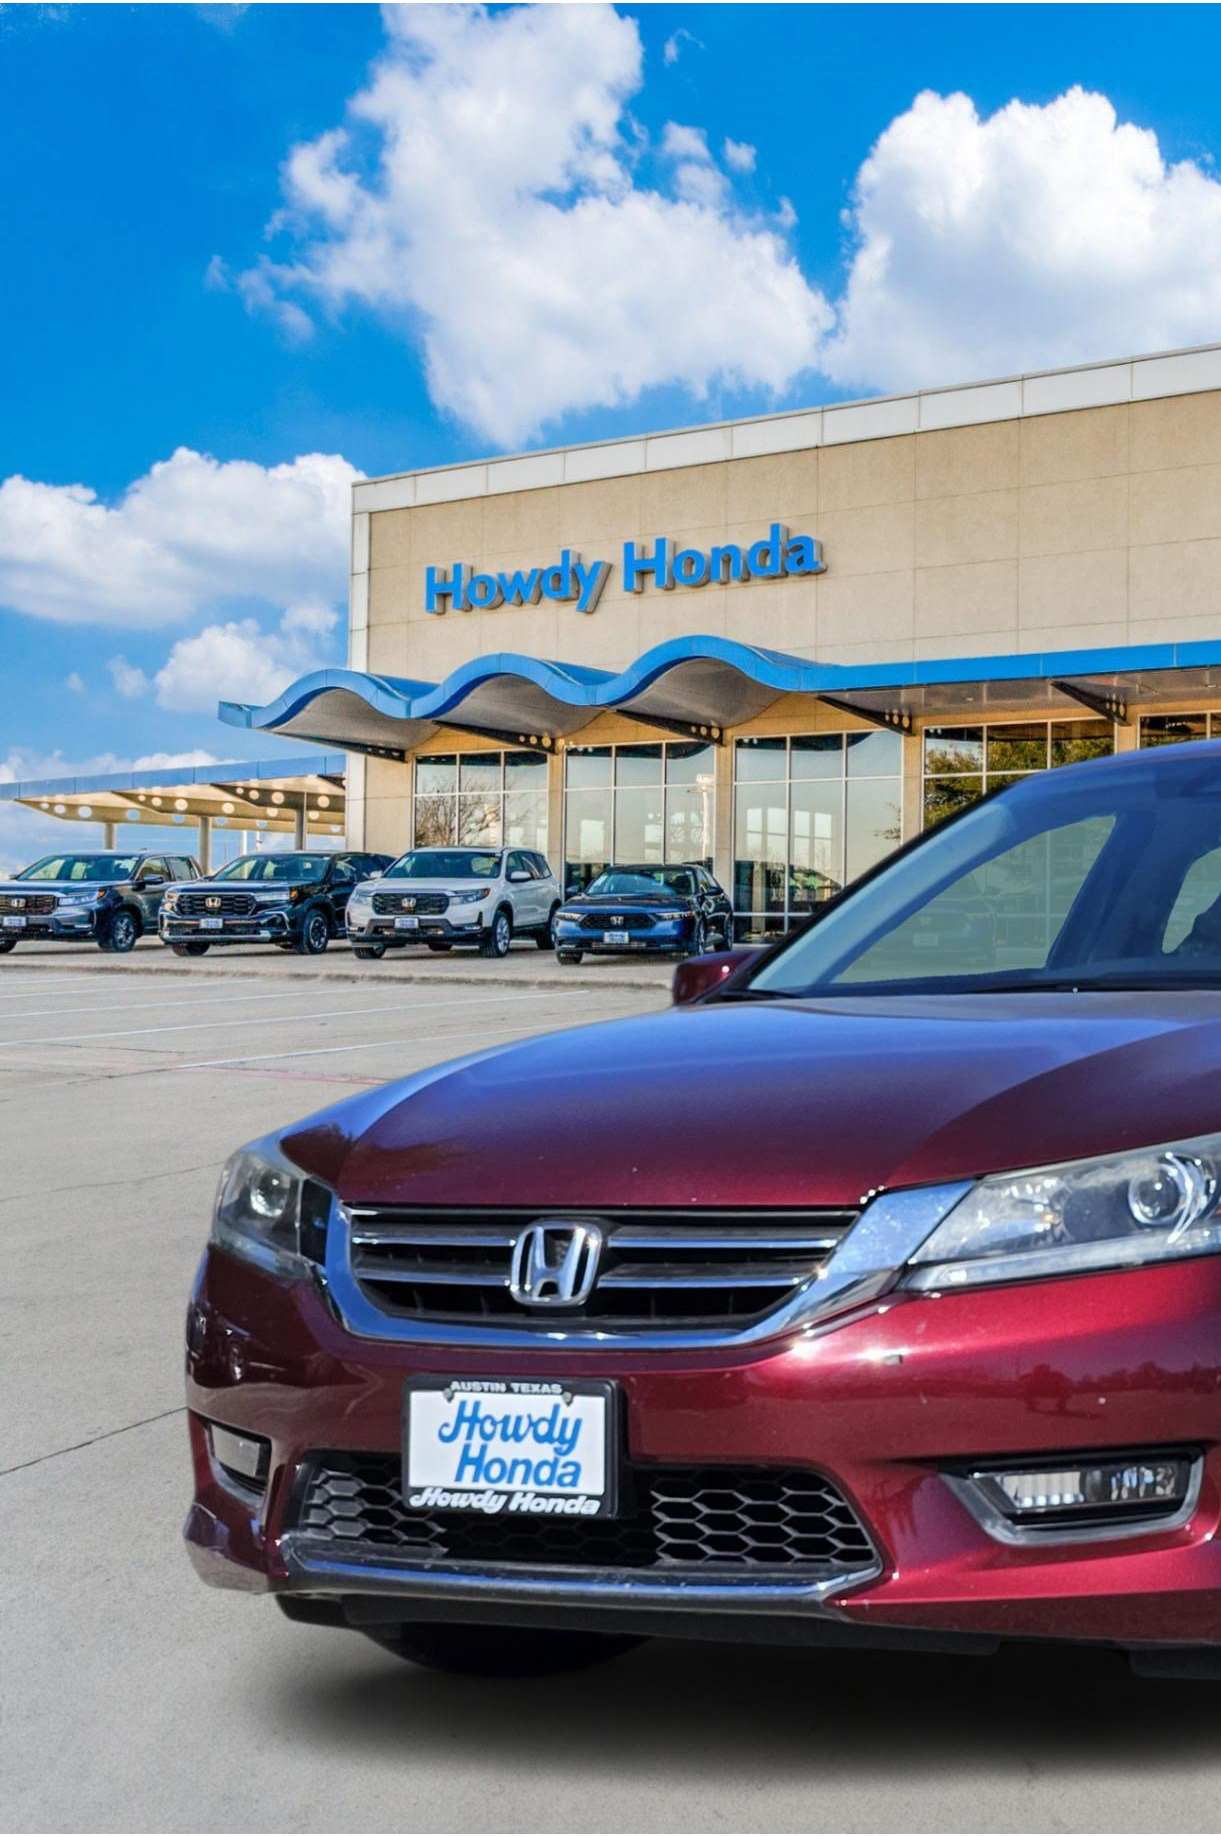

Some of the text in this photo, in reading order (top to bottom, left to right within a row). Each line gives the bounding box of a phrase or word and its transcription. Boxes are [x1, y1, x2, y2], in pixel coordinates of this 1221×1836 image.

[425, 523, 827, 614] Howdy Honda
[450, 1381, 563, 1394] AUSTIN TEXAS
[438, 1400, 582, 1457] Howdy
[454, 1443, 582, 1488] Honda
[409, 1487, 601, 1516] Howdy Honda
